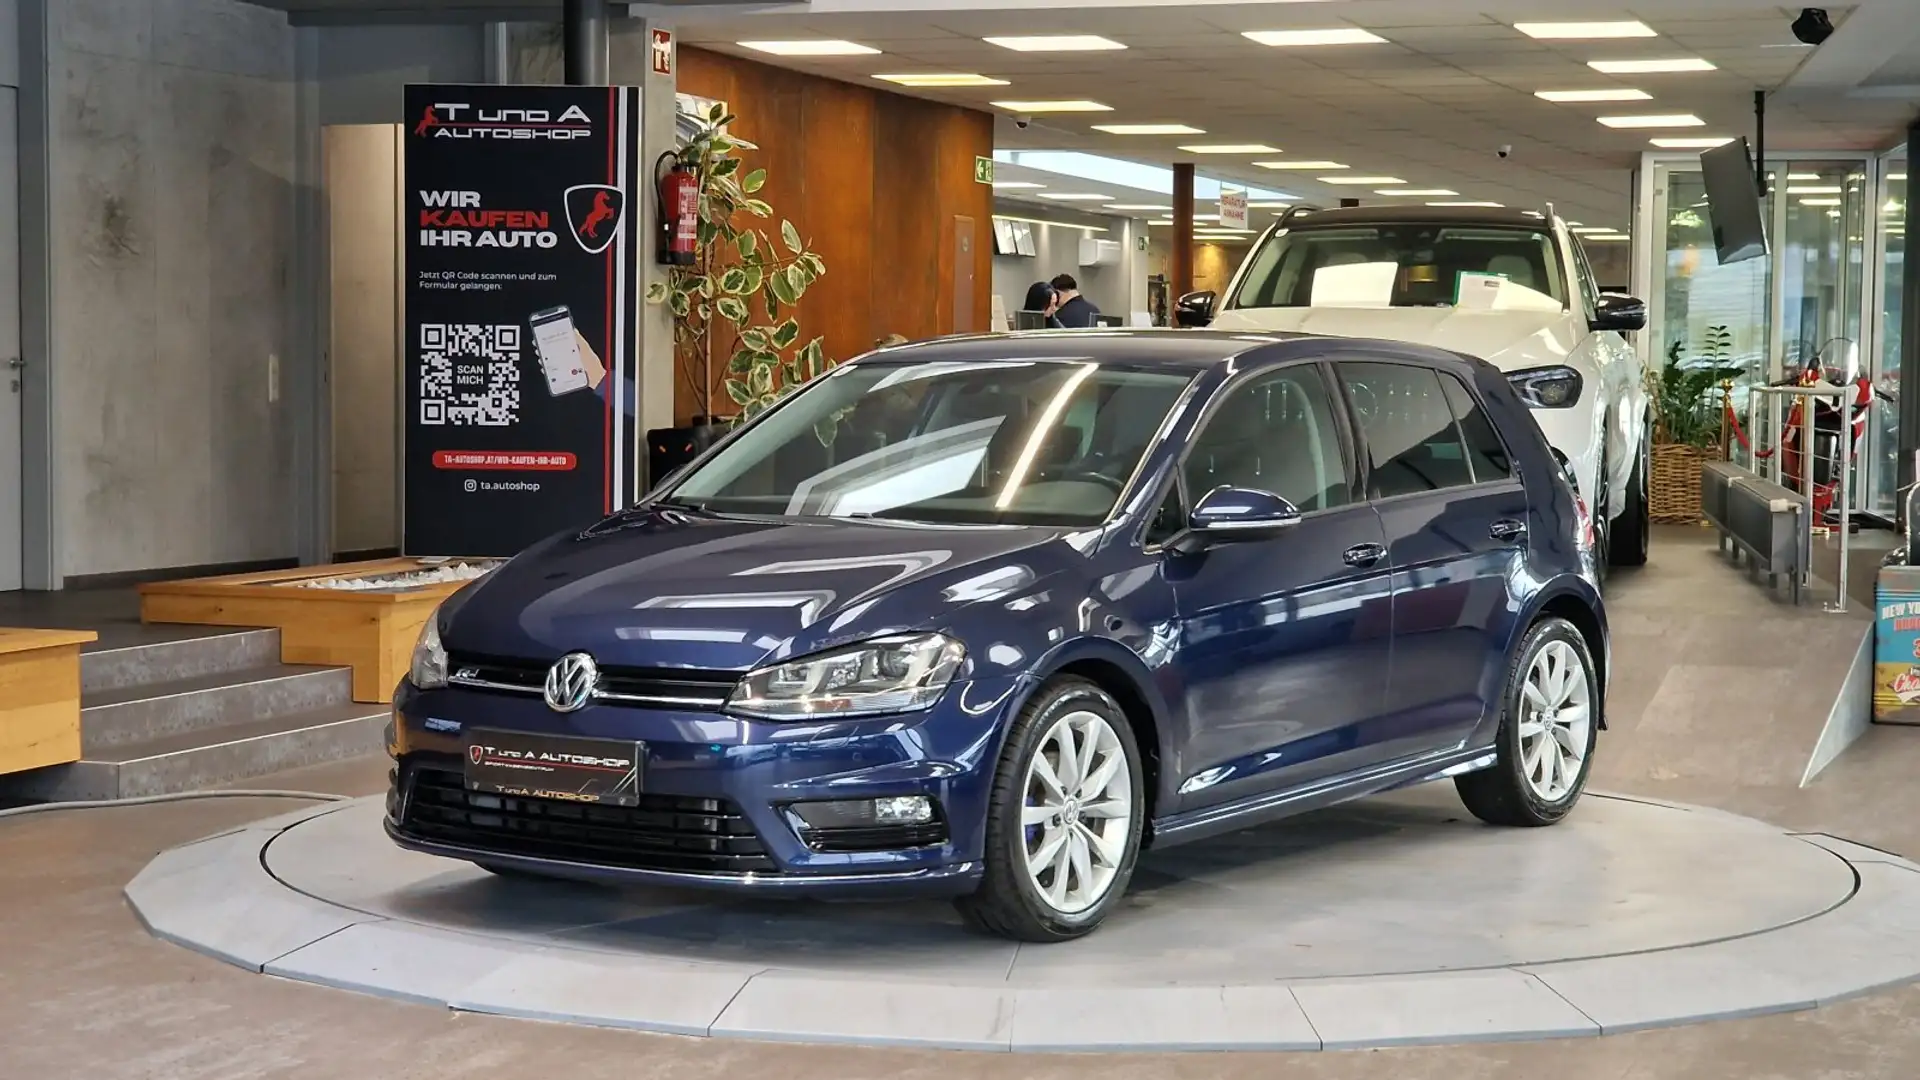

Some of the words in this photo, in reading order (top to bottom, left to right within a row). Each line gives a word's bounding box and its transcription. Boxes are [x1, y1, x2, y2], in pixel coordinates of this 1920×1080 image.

[434, 102, 470, 121] T
[557, 104, 592, 123] A
[434, 128, 592, 140] AUTOSHOP
[419, 190, 481, 208] WIR
[419, 210, 549, 228] KAUFEN
[420, 230, 472, 247] IHR
[474, 231, 558, 248] AUTO
[419, 271, 440, 279] Jetzt
[441, 271, 456, 280] QR
[457, 271, 480, 280] Code
[481, 272, 518, 281] scannen
[519, 272, 537, 281] und
[419, 281, 458, 290] Formular
[457, 365, 484, 375] SCAN
[457, 375, 484, 385] MICH
[480, 481, 540, 492] ta.autoshop
[1882, 602, 1905, 620] NEW
[485, 746, 496, 754] T
[524, 751, 535, 759] A
[540, 752, 630, 767] AUTOSHOP
[532, 789, 600, 802] AUTOSHOP
